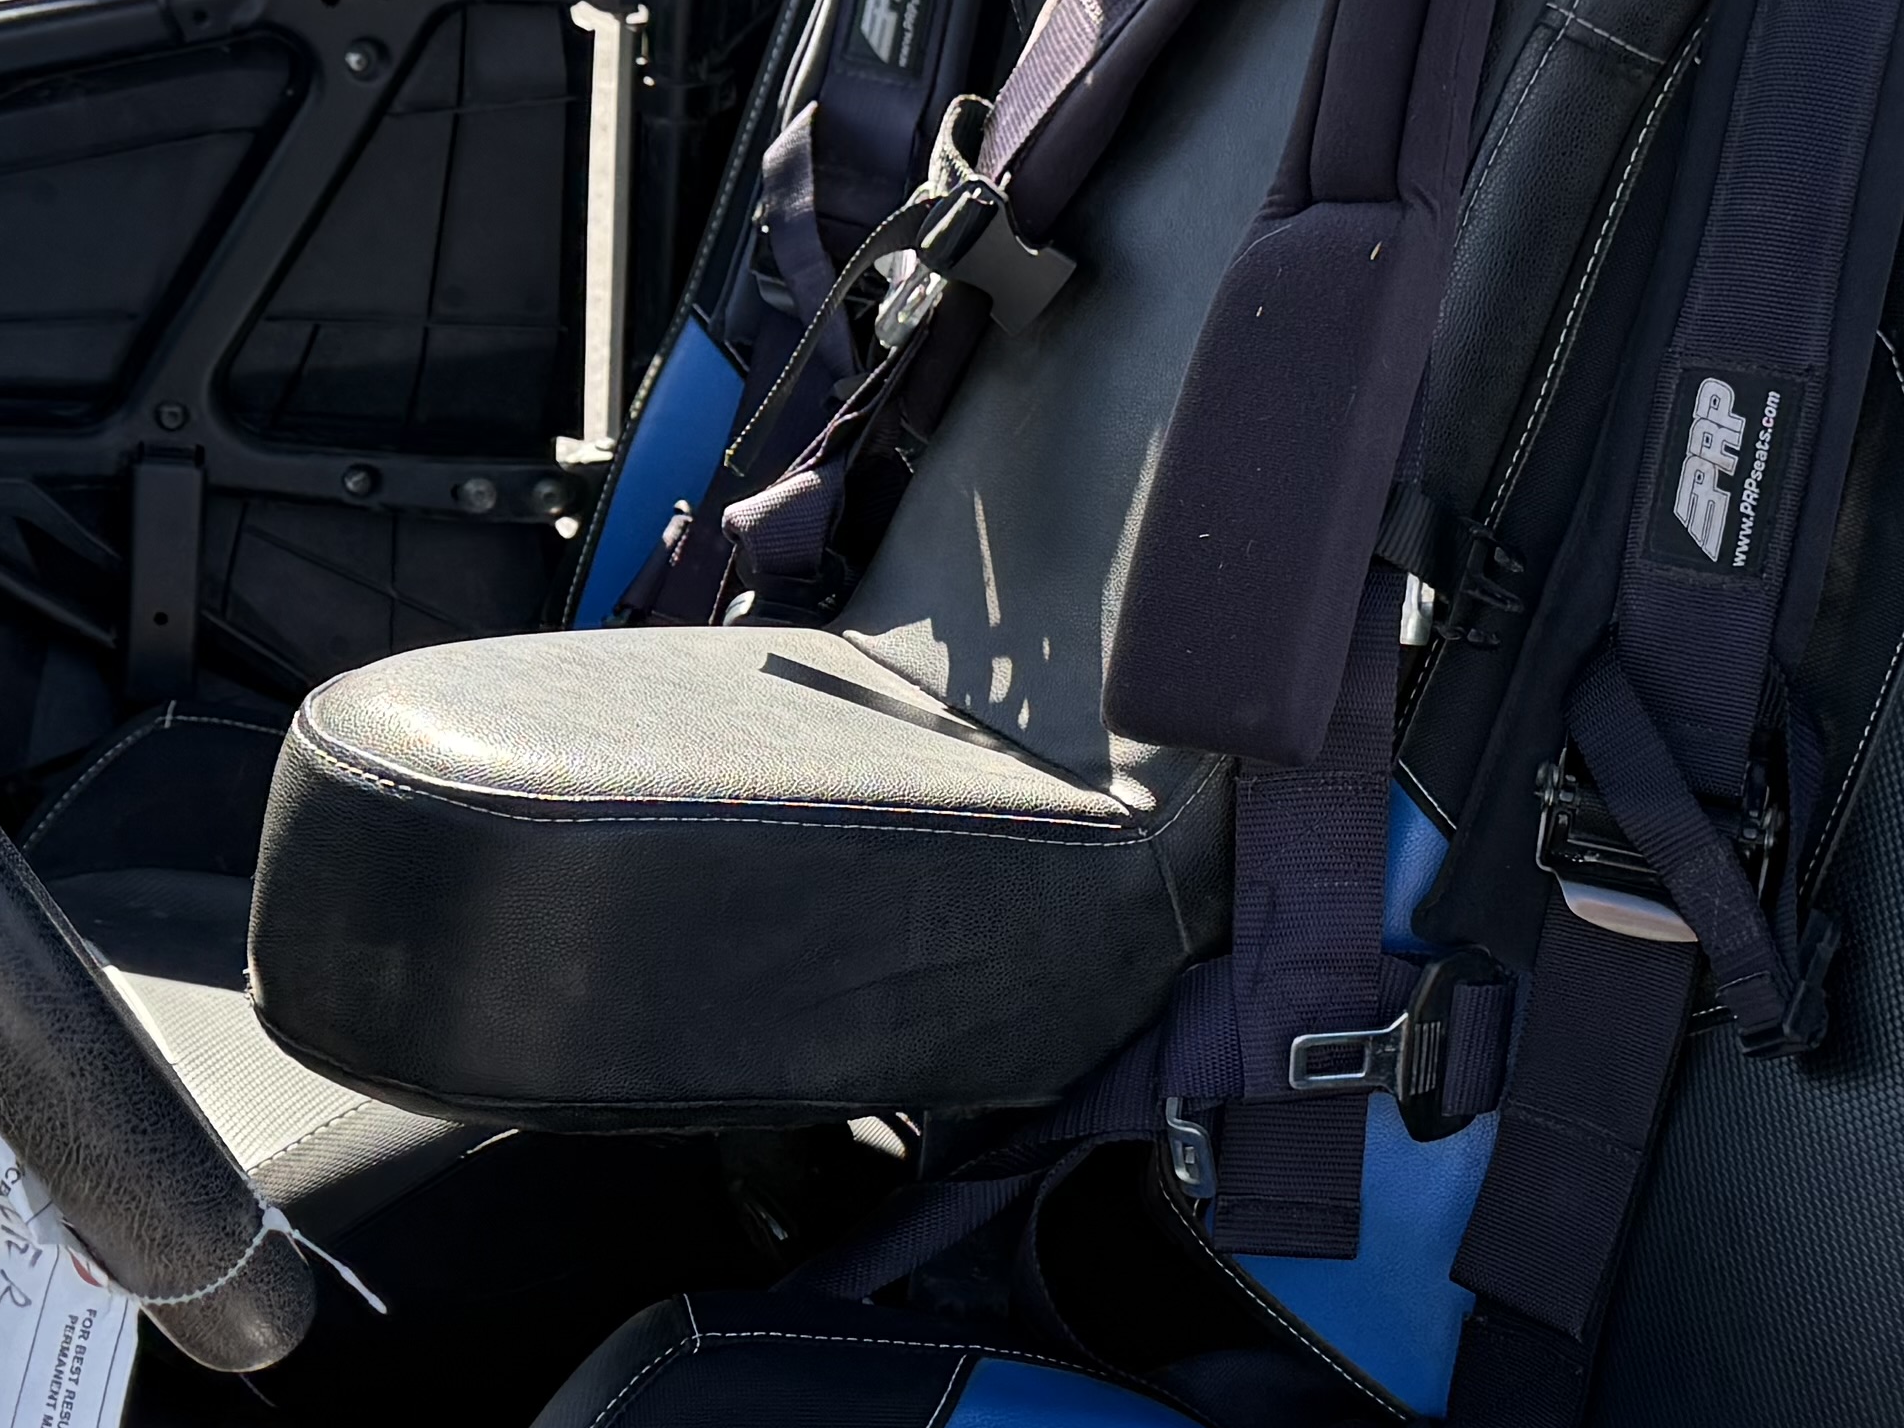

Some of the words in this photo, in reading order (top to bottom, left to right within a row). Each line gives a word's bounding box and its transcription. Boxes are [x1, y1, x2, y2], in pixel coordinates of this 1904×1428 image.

[1673, 377, 1747, 563] PRP
[1732, 390, 1781, 568] www.PRPseats.com
[46, 1314, 79, 1412] PERMANENT
[69, 1345, 87, 1387] BEST
[76, 1308, 97, 1342] FOR
